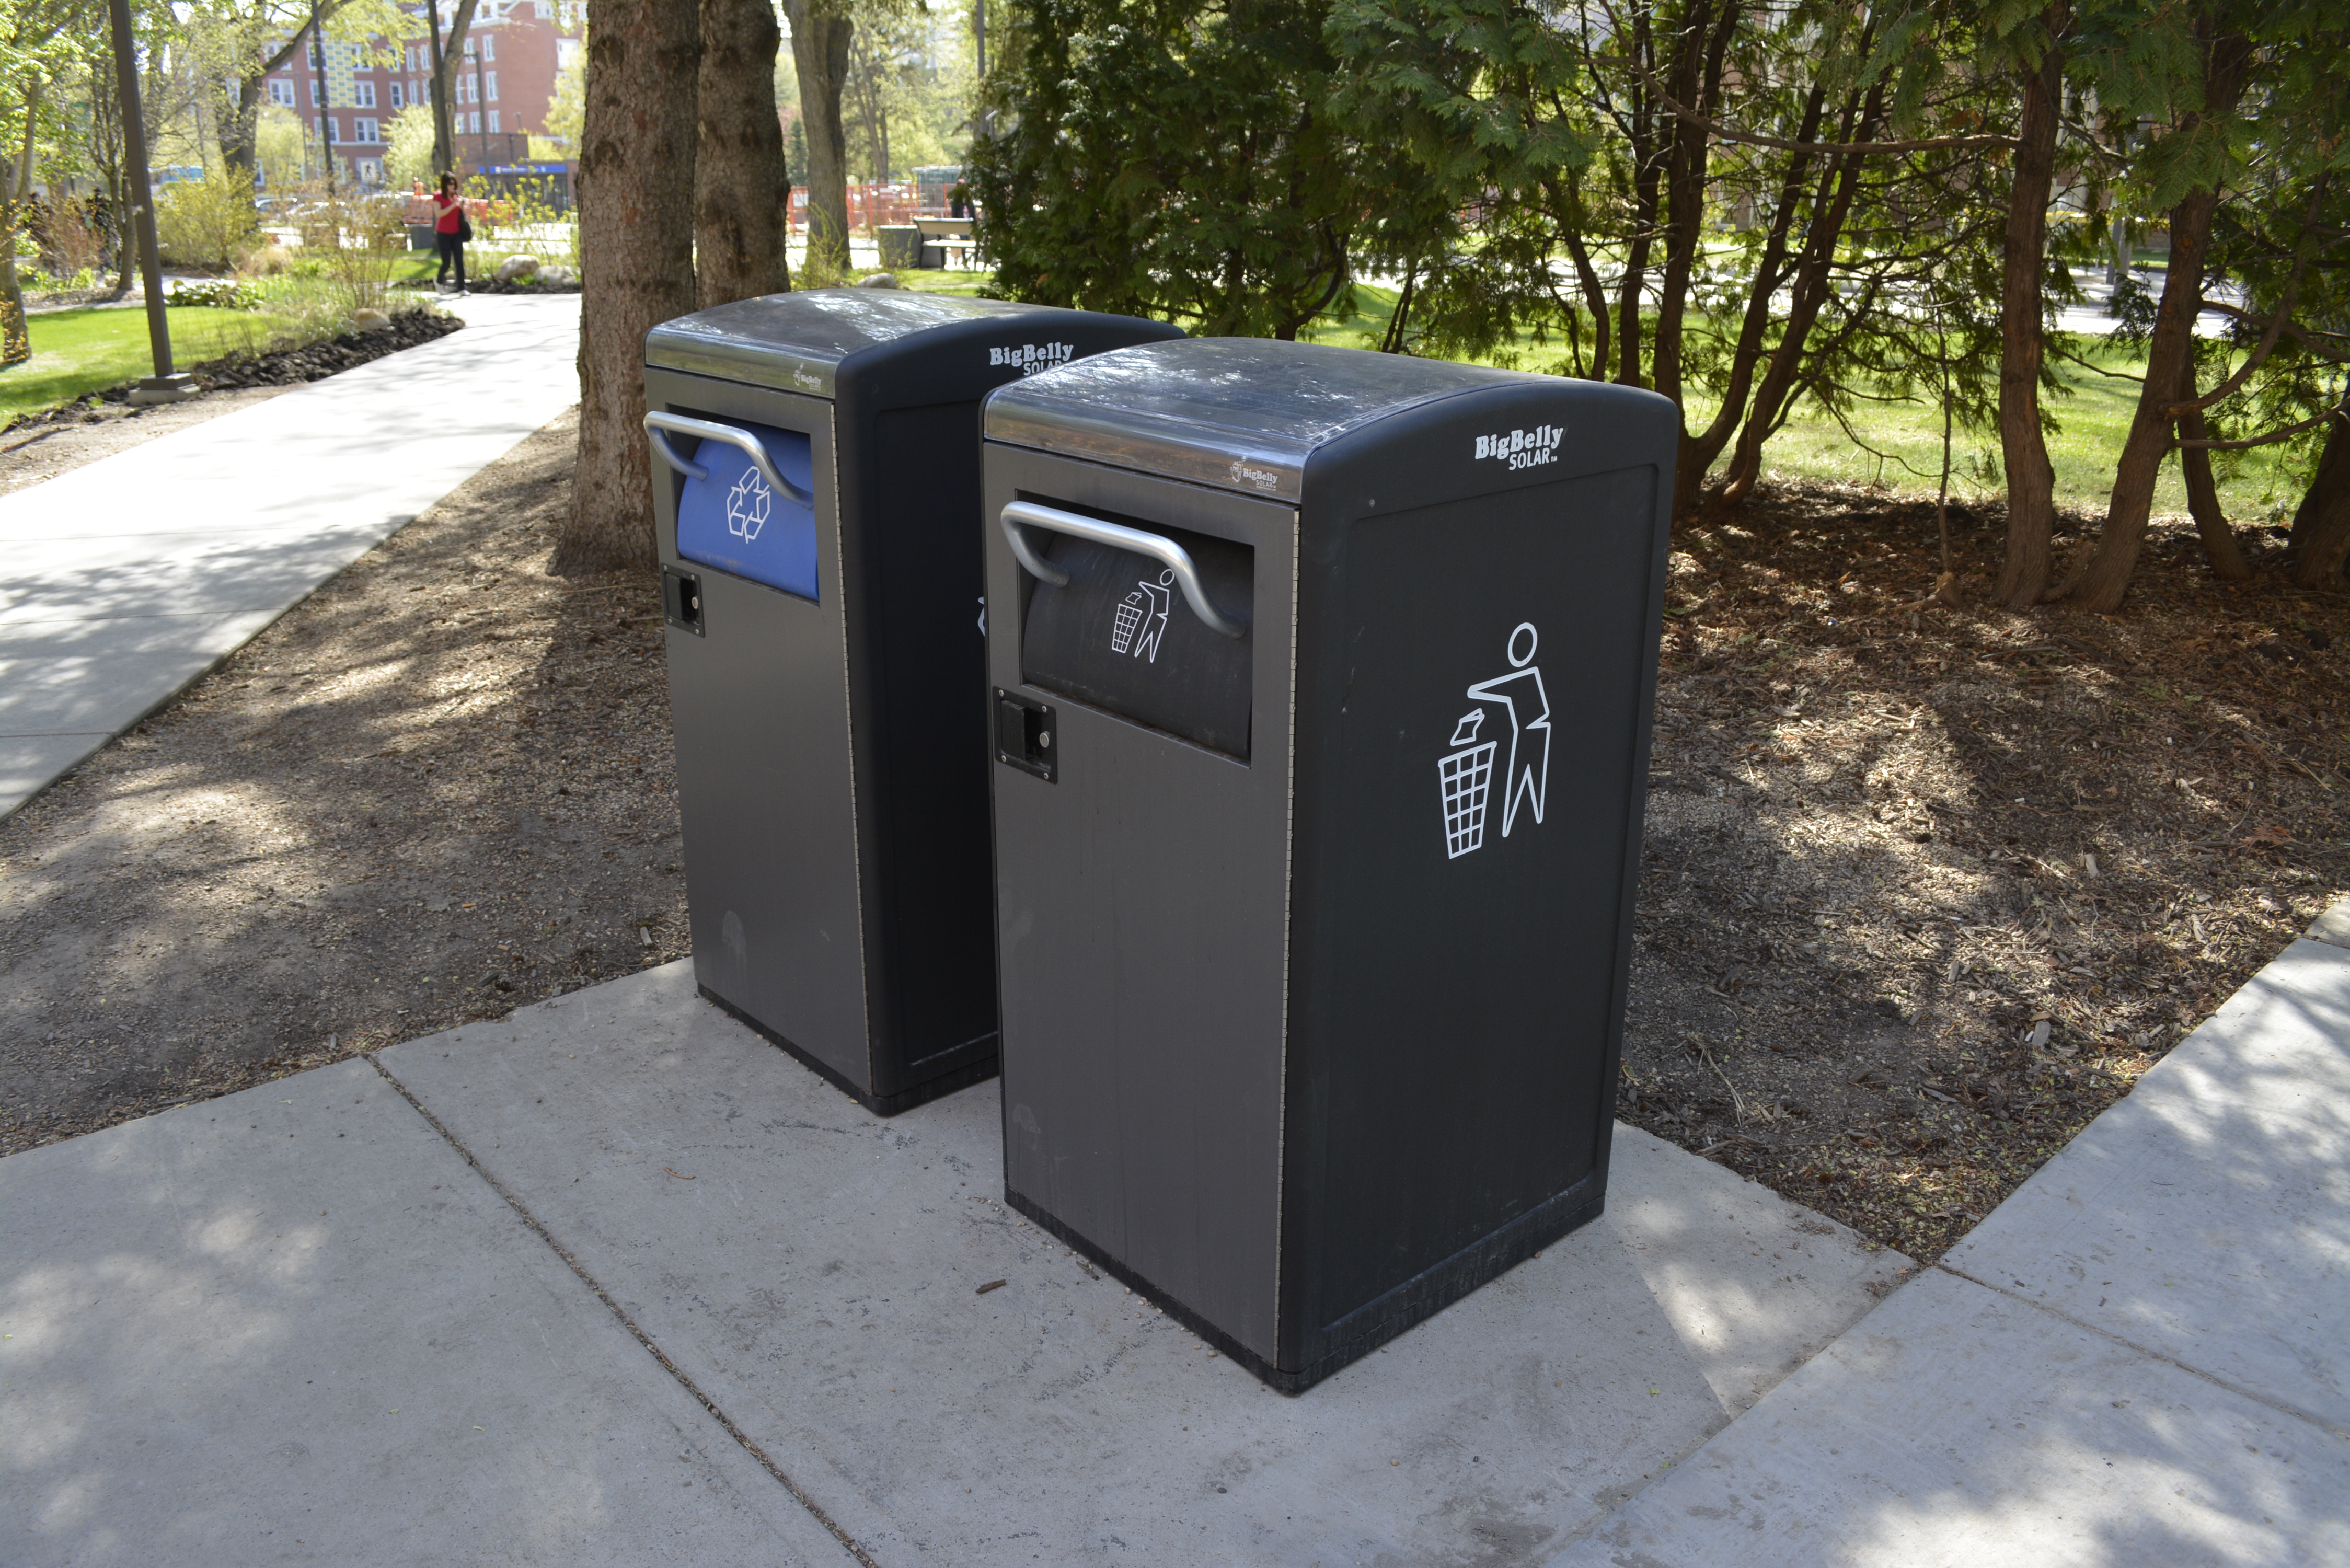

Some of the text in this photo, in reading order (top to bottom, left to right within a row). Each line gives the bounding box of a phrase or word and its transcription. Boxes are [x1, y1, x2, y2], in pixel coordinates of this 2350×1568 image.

[989, 342, 1074, 367] BigBelly
[801, 374, 821, 385] BigBelly
[1475, 425, 1563, 459] BigBelly
[1508, 447, 1550, 470] SOLAR
[1243, 468, 1278, 484] BigBelly
